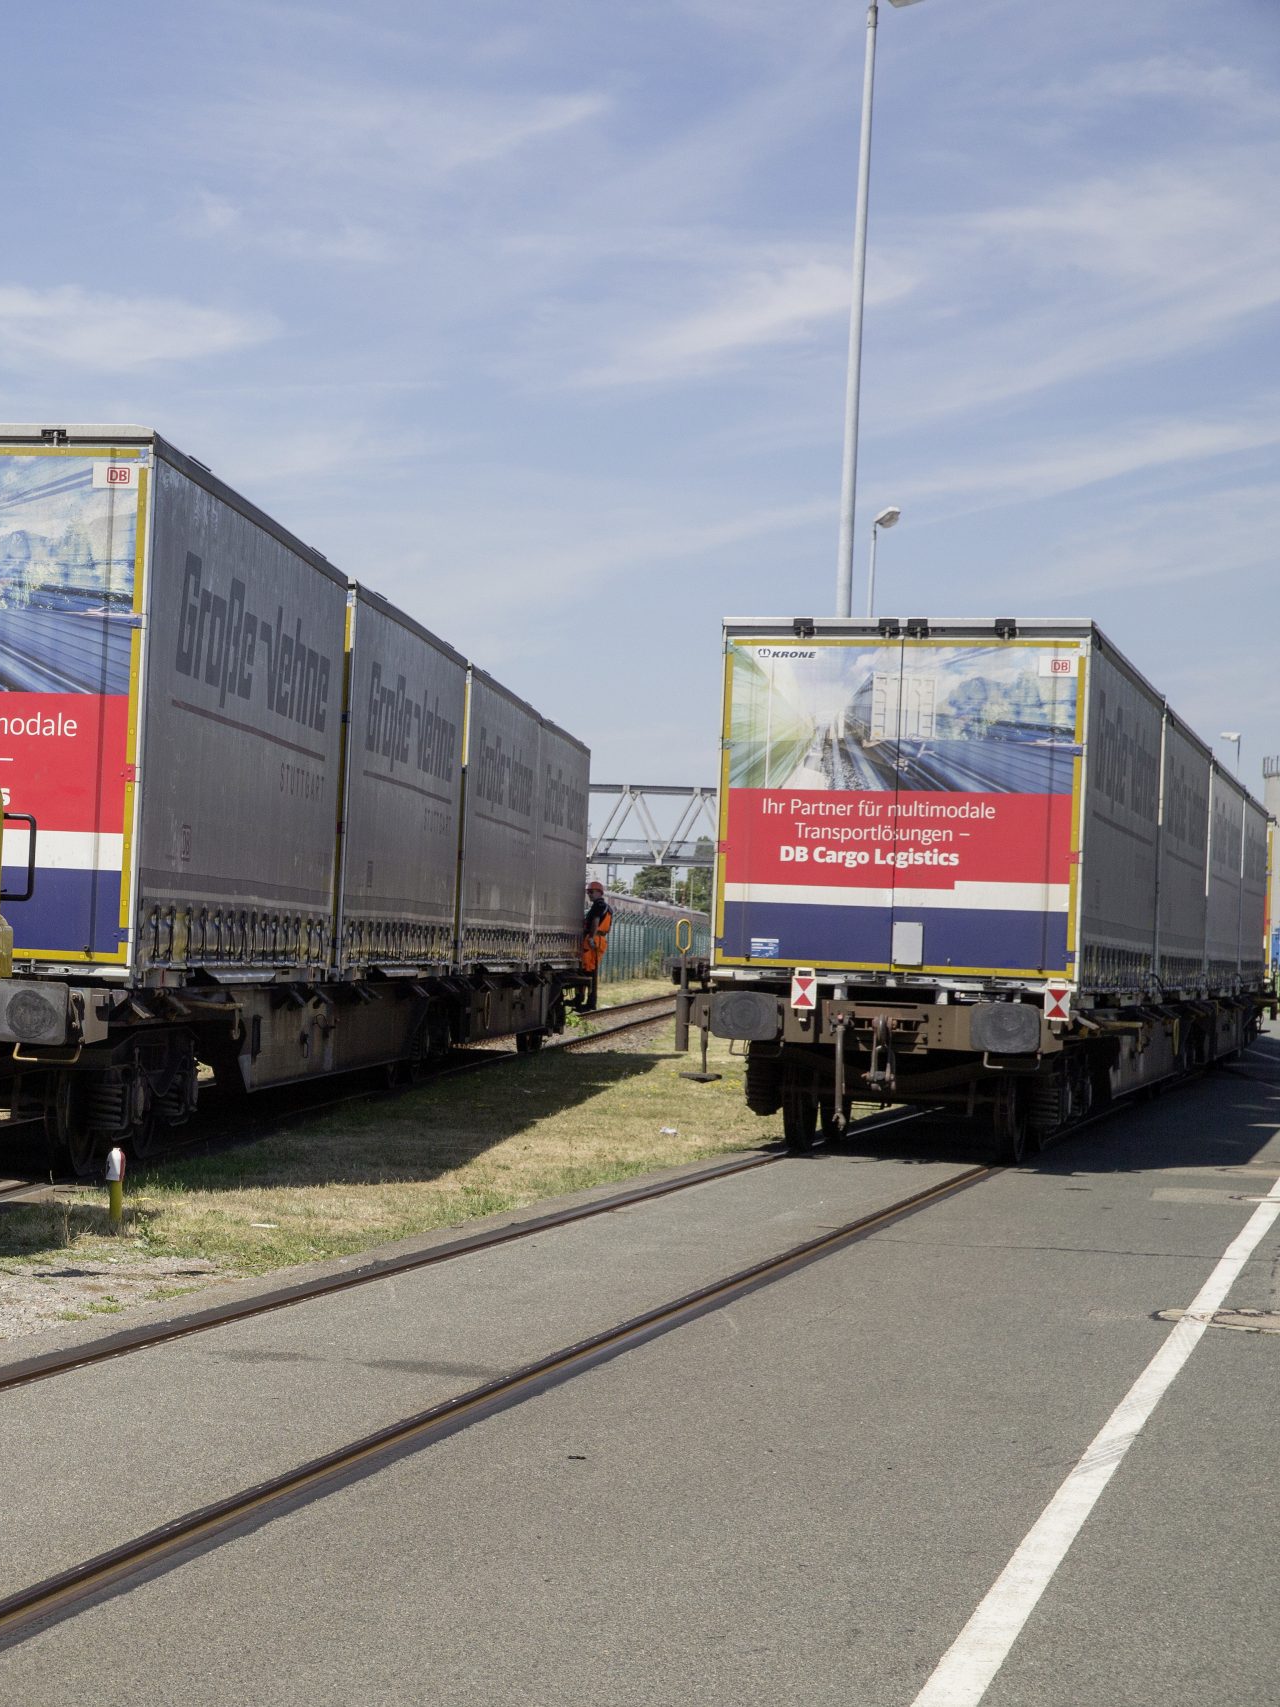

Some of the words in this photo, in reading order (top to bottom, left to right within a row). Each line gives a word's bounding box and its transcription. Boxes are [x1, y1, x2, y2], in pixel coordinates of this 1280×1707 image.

[109, 469, 128, 482] DB
[1053, 661, 1068, 671] DB
[280, 762, 325, 802] STUTTGART
[762, 798, 785, 815] Ihr
[790, 798, 854, 817] Partner
[858, 799, 883, 817] für
[888, 801, 996, 819] multimodale
[795, 822, 953, 845] Transportlösungen
[780, 846, 808, 863] DB
[813, 846, 869, 868] Cargo
[874, 848, 960, 869] Logistics
